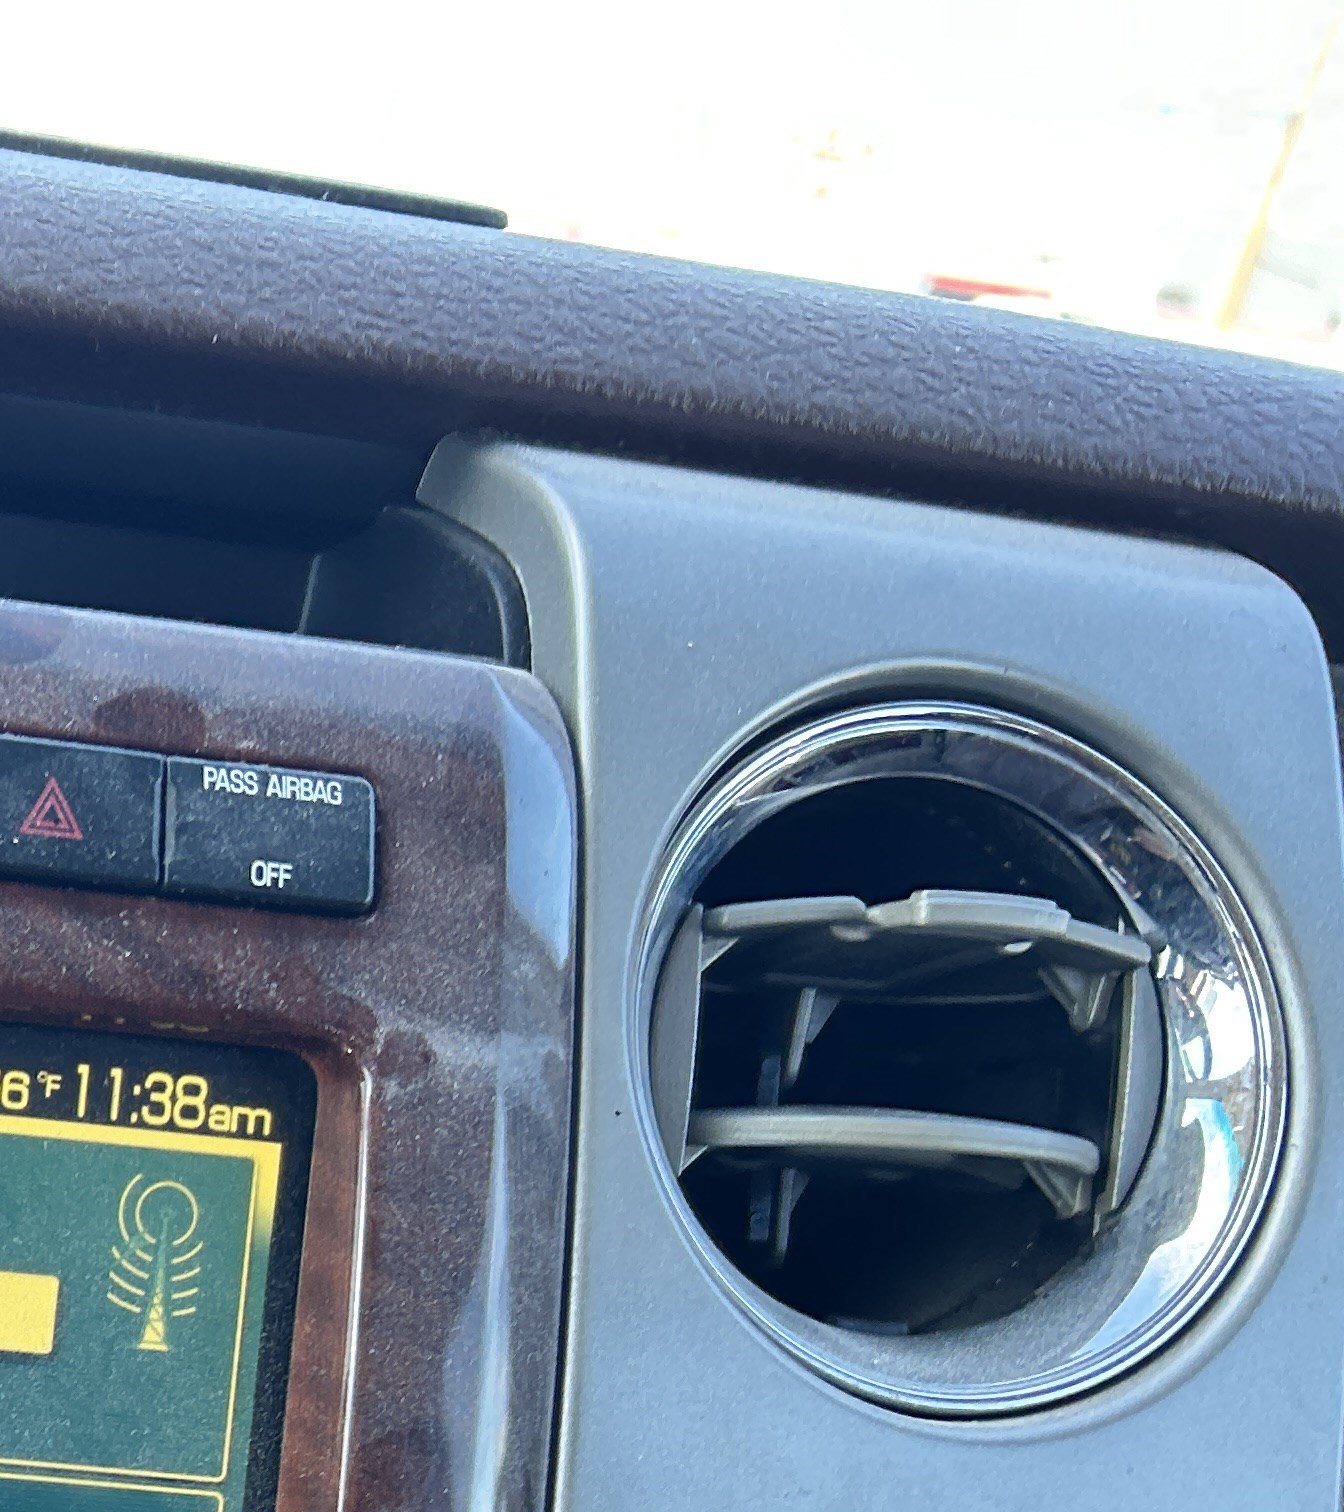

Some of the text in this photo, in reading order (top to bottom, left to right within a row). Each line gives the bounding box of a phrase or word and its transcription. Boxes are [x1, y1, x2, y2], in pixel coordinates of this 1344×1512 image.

[202, 766, 343, 806] PASS AIRBAG
[249, 860, 293, 890] OFF
